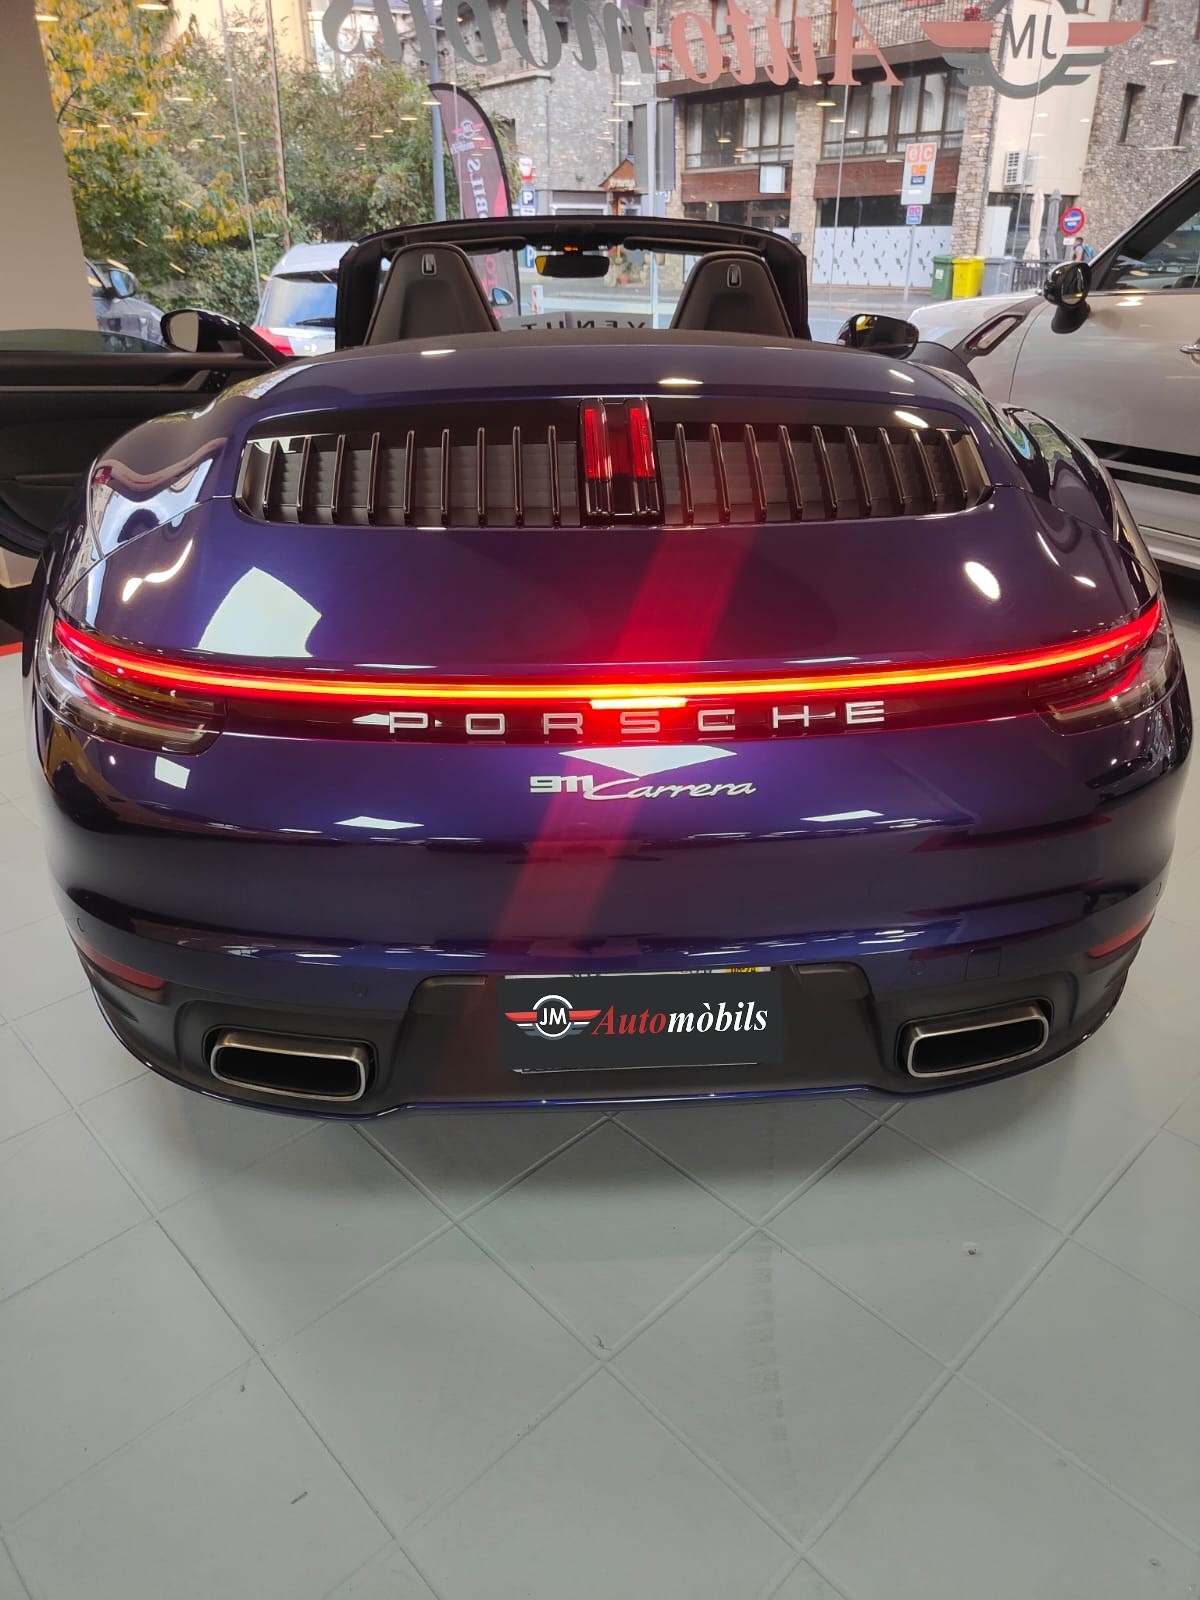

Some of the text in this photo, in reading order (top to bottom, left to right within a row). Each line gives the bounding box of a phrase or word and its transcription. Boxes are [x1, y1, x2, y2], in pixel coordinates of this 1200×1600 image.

[389, 700, 885, 735] PORSCHE
[530, 775, 756, 801] 911 Carrera
